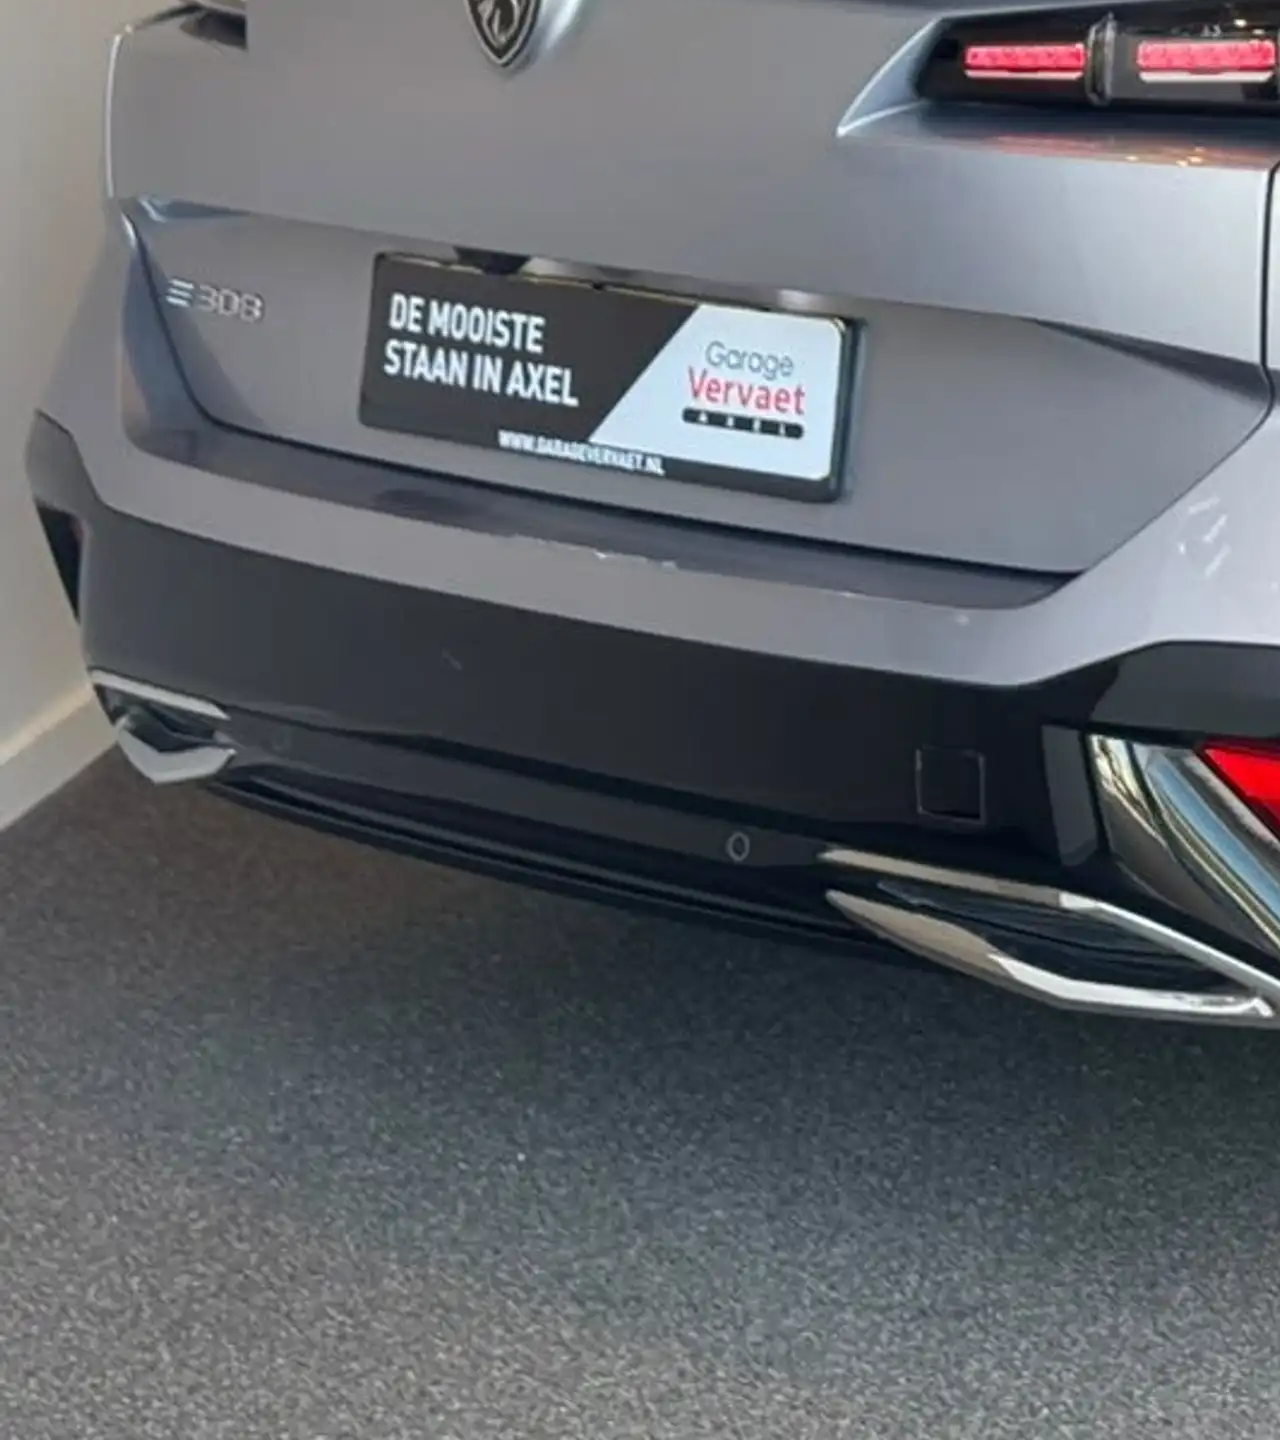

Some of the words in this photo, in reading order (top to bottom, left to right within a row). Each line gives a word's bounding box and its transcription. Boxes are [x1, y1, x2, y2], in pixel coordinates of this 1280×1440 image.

[388, 292, 425, 334] DE
[427, 298, 546, 355] MOOISTE
[384, 338, 469, 389] STAAN
[473, 353, 503, 395] IN
[506, 360, 580, 408] AXEL
[704, 339, 794, 381] Garage
[687, 364, 806, 416] Vervaet
